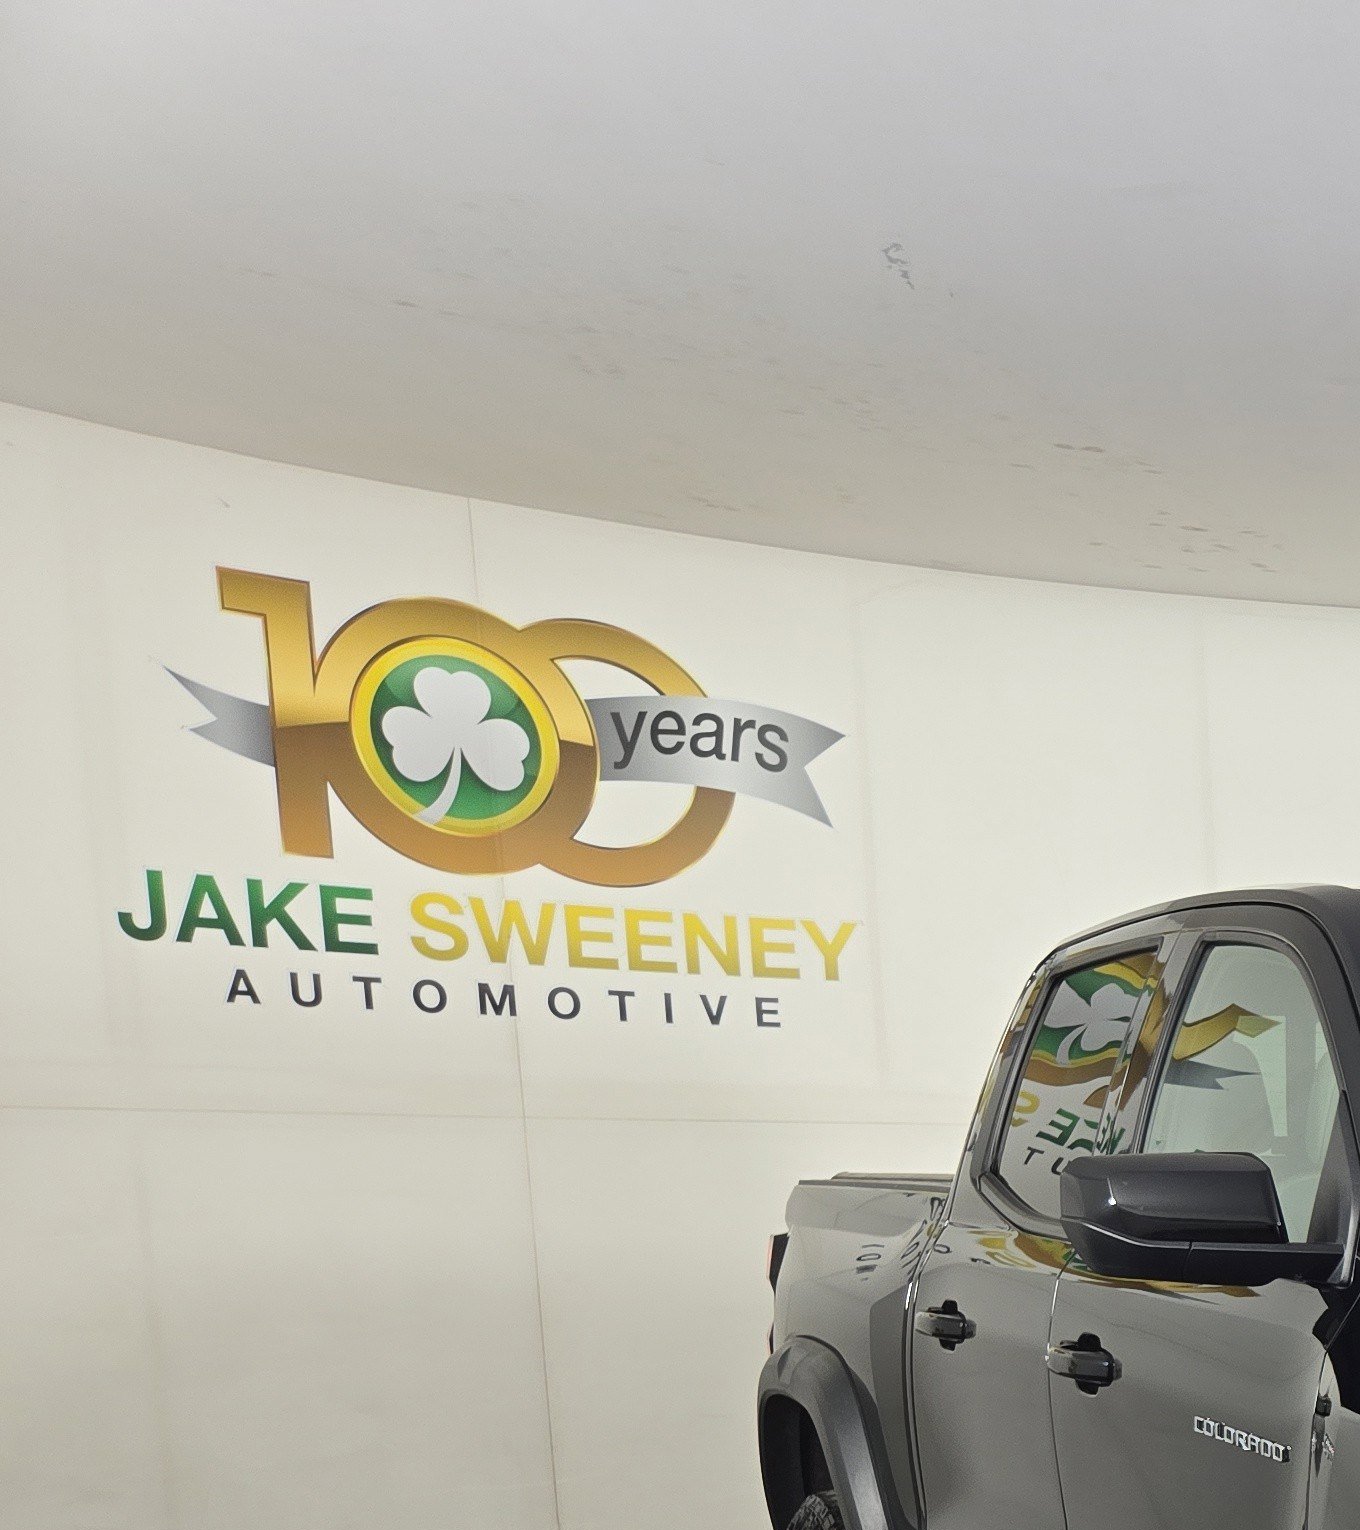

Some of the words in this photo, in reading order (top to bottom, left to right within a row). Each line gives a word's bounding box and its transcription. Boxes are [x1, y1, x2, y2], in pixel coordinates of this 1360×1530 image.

[611, 704, 792, 774] years
[117, 869, 379, 955] JAKE
[409, 892, 860, 982] SWEENEY
[227, 969, 782, 1029] AUTOMOTIVE
[1193, 1415, 1291, 1463] COLORADO
